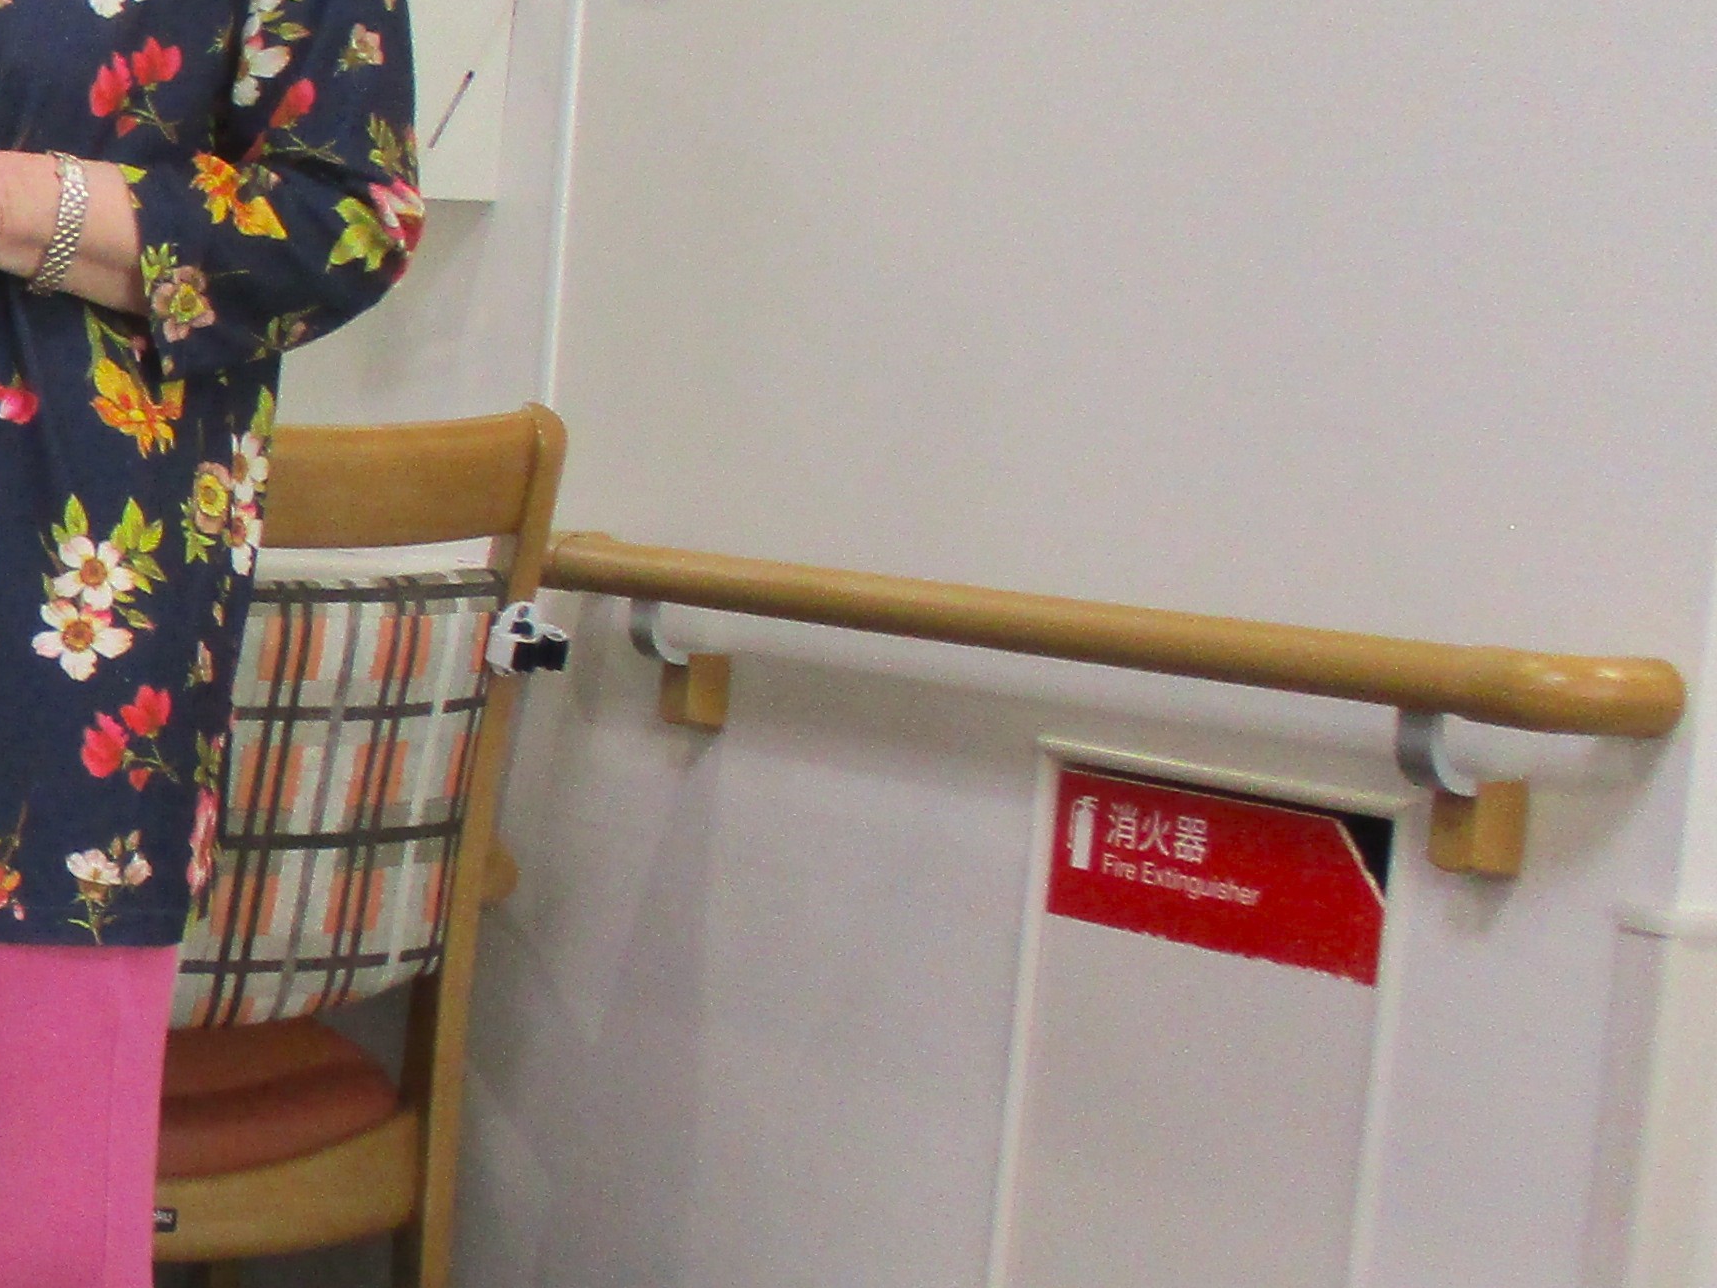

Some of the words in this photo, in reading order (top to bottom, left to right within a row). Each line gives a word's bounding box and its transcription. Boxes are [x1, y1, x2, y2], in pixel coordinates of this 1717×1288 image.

[1106, 803, 1208, 863] 消火器
[1103, 853, 1135, 880] Fire
[1142, 861, 1261, 906] Extinguisher
